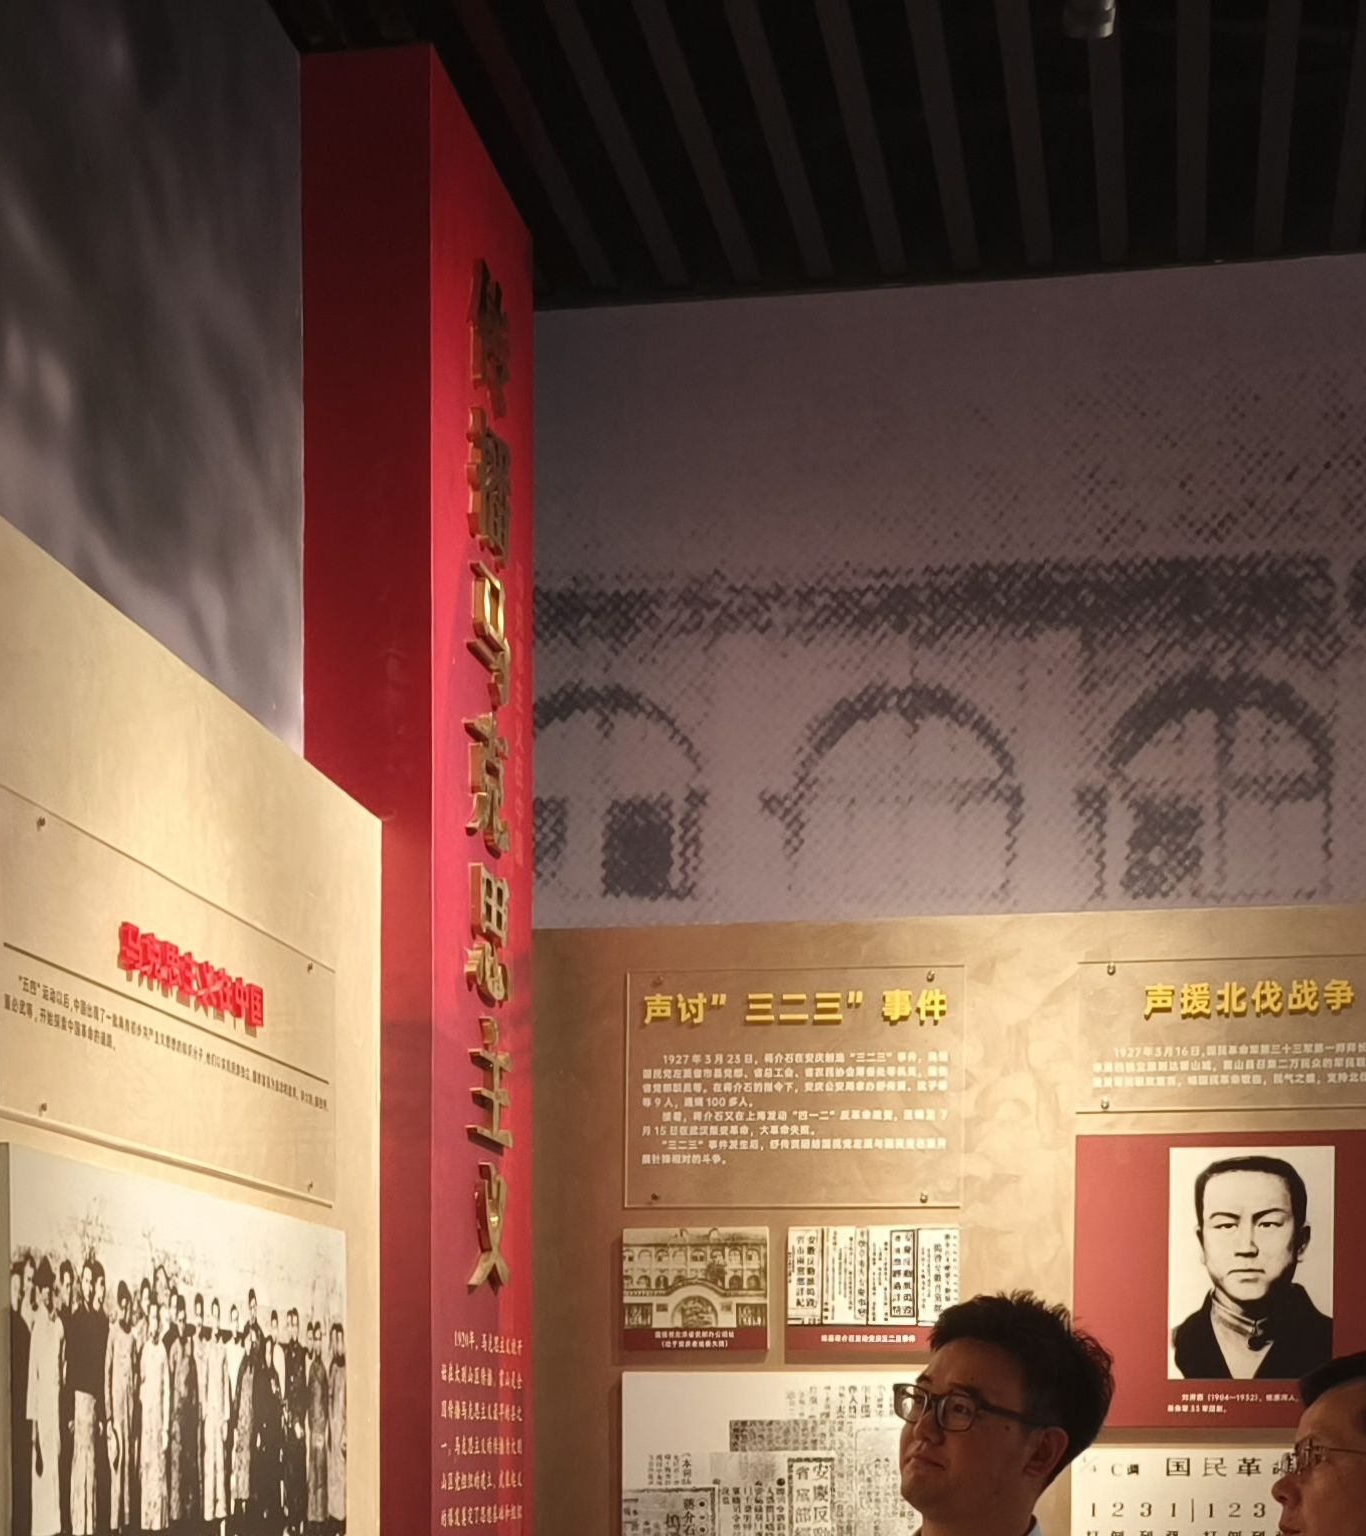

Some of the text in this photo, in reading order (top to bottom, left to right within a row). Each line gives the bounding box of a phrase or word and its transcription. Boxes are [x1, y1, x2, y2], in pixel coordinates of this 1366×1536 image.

[1144, 979, 1355, 1019] 声援北伐战争
